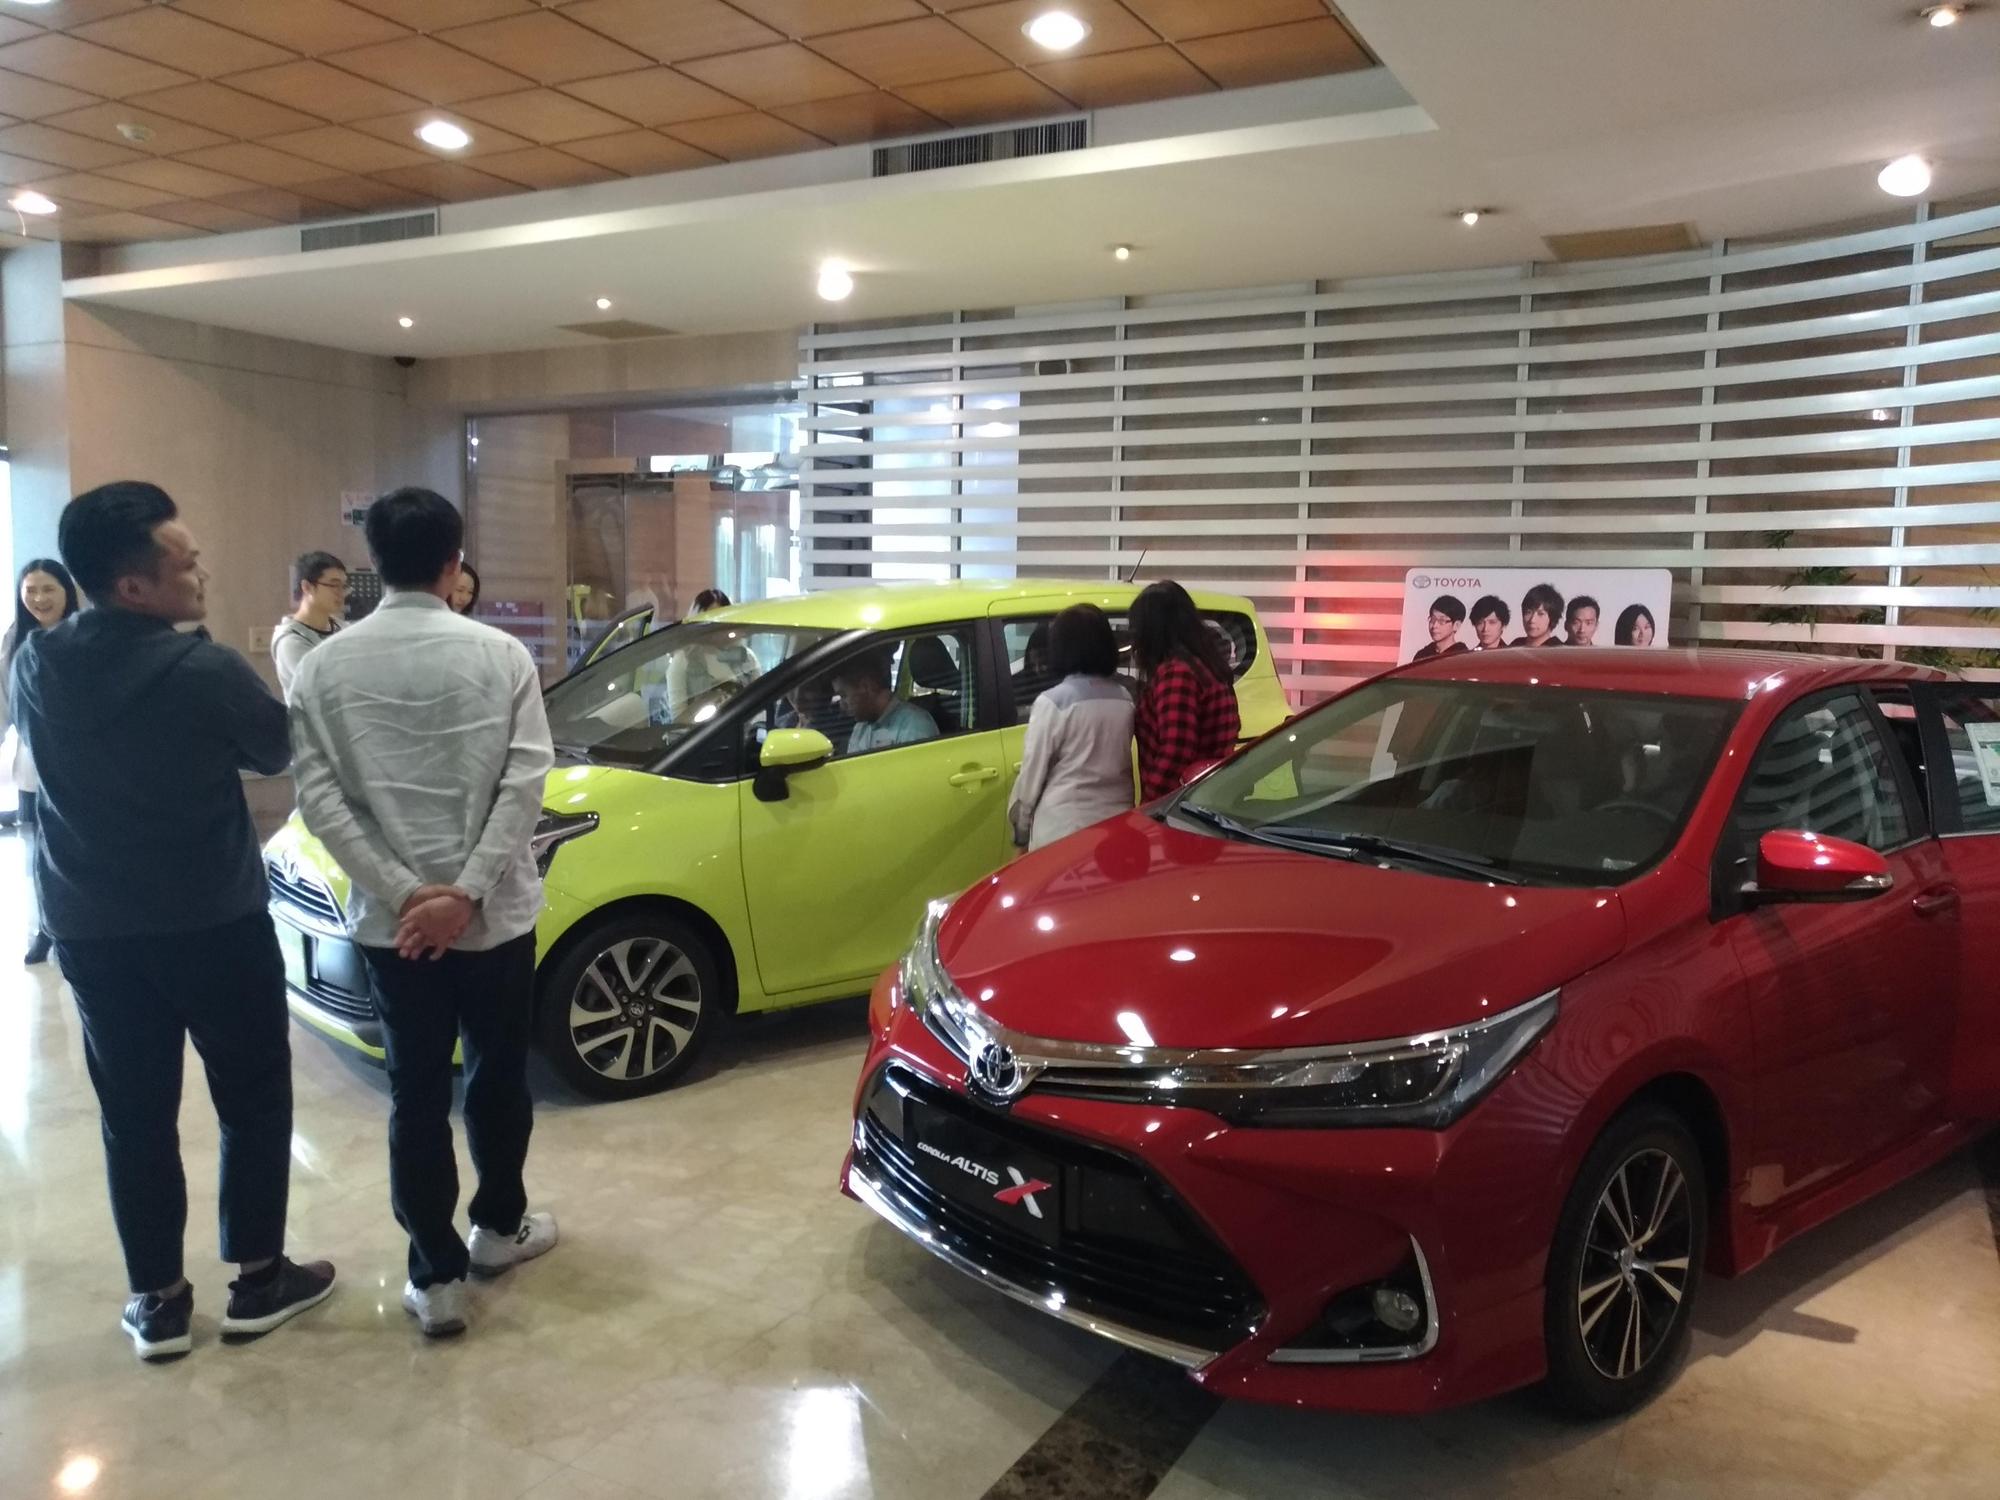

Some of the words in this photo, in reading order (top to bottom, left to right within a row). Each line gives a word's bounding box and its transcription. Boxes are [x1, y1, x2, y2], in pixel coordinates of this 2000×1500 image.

[1433, 577, 1481, 588] TOYOTA
[916, 1141, 950, 1163] COROLLA
[951, 1156, 999, 1186] ALTIS
[993, 1166, 1052, 1219] X
